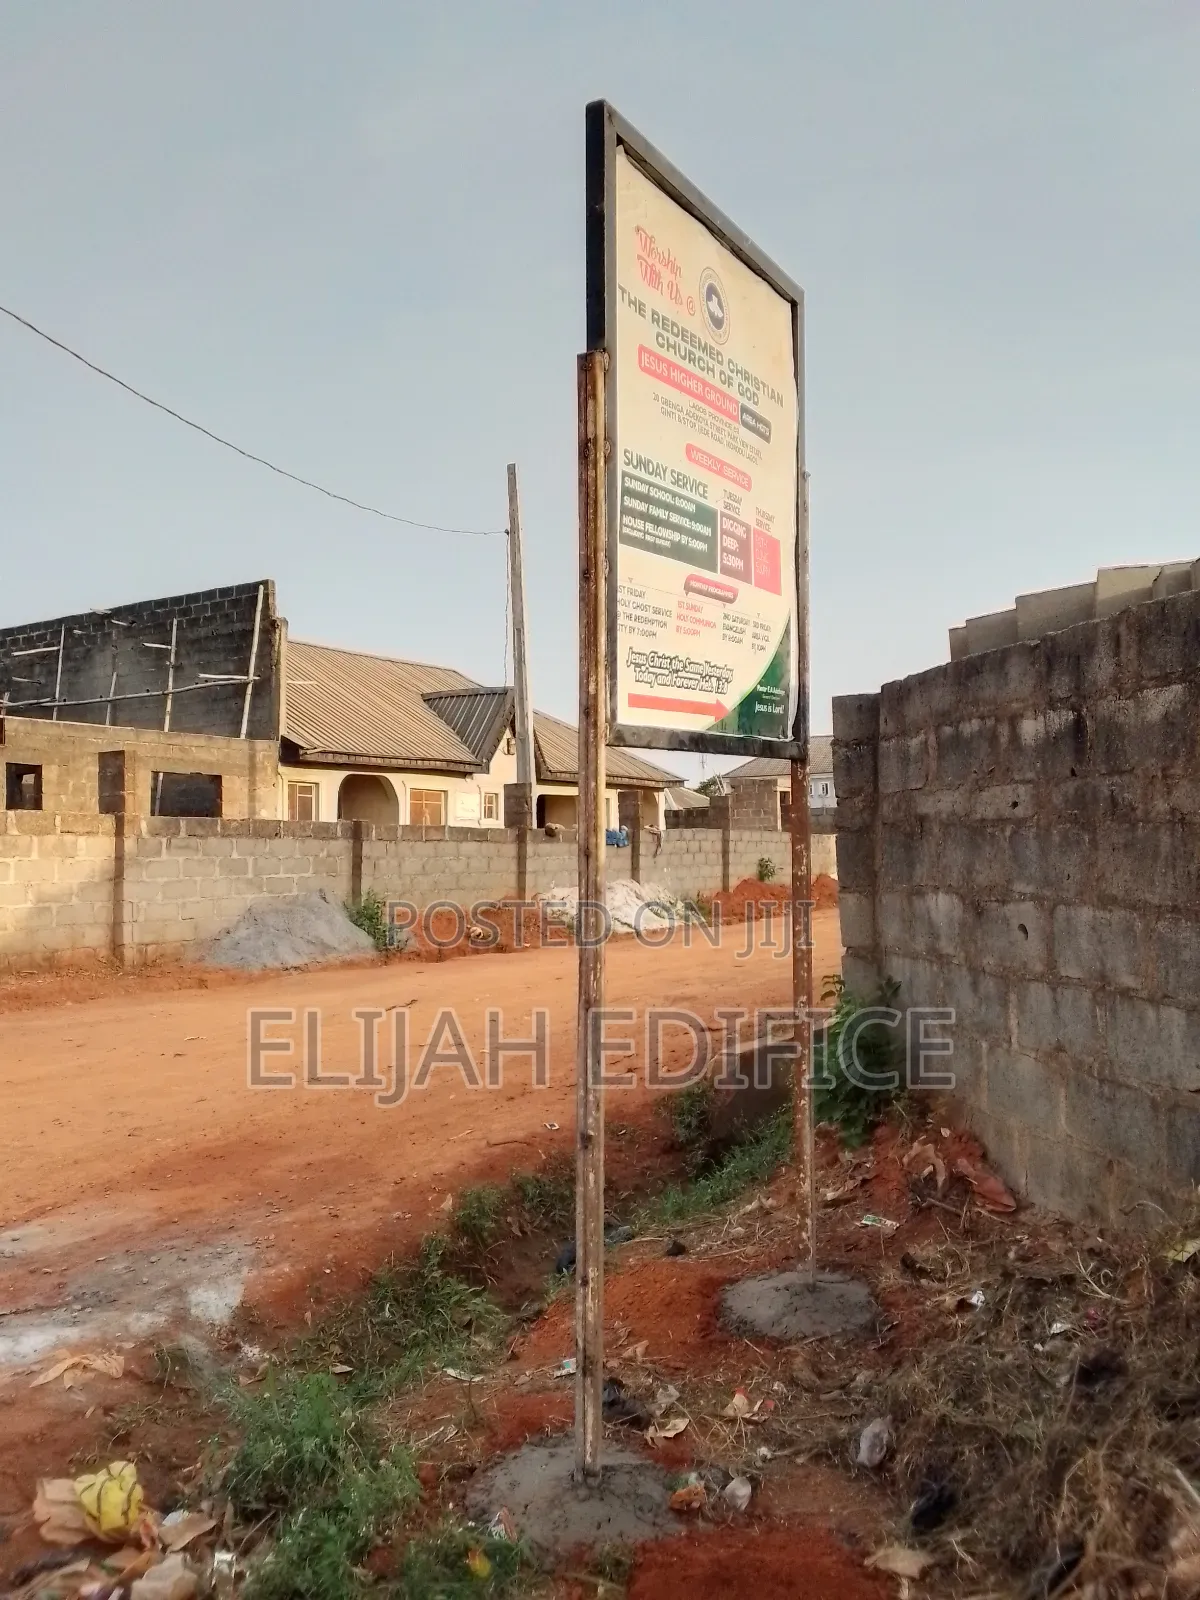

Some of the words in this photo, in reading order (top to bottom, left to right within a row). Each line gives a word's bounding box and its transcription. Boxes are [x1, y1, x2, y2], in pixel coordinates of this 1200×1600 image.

[635, 225, 682, 278] Worship
[637, 253, 664, 296] With
[667, 275, 682, 307] Us
[686, 292, 695, 319] @
[618, 282, 646, 319] THE
[652, 304, 723, 369] REDEEMED
[727, 356, 783, 407] CHRISTIAN
[656, 327, 715, 381] CHURCH
[719, 368, 733, 390] OF
[737, 380, 758, 407] GOD
[641, 348, 667, 382] JESUS
[670, 364, 703, 398] HIGHER
[704, 384, 737, 416] GROUND
[623, 446, 667, 484] SUNDAY
[670, 467, 708, 500] SERVICE
[690, 447, 720, 472] WEEKLY
[723, 464, 748, 487] SERVICE
[624, 475, 648, 495] SUNDAY
[623, 494, 648, 513] SUNDAY
[649, 503, 668, 520] FAMILY
[622, 512, 644, 531] HOUSE
[645, 520, 680, 544] FELLOWSHIP
[722, 551, 743, 571] 5:30PM
[626, 585, 645, 599] FRIDAY
[622, 611, 633, 622] THE
[633, 613, 667, 630] REDEMPTION
[632, 600, 650, 613] GHOST
[651, 605, 672, 618] SERVICE
[676, 611, 689, 623] HOLY
[628, 625, 635, 634] BY
[626, 645, 646, 670] Jesus
[671, 654, 684, 672] the
[634, 664, 656, 687] Today
[656, 668, 670, 686] and
[671, 672, 698, 690] Forever
[754, 700, 767, 714] Jesus
[768, 703, 771, 712] is
